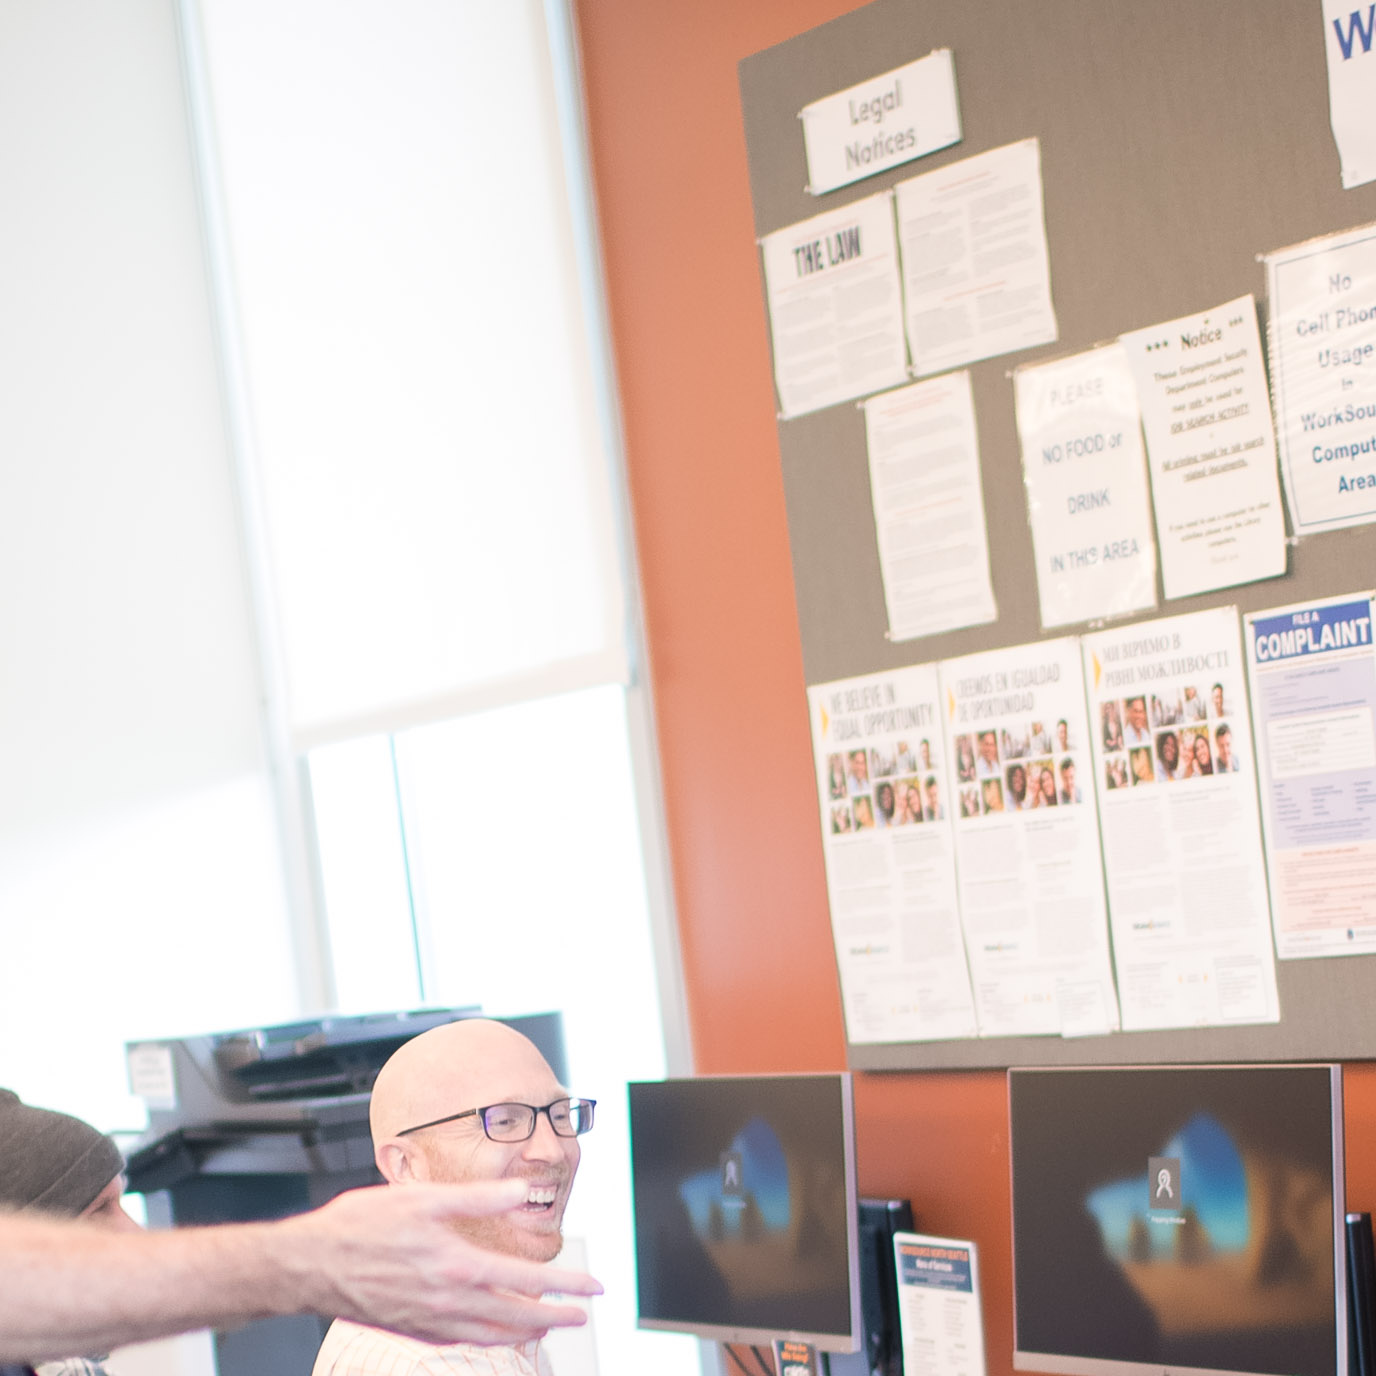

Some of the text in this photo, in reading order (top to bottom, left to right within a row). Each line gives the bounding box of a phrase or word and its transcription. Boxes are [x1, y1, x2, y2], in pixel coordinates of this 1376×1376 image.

[848, 79, 903, 125] Legal
[845, 128, 916, 171] Notices
[792, 240, 823, 278] THE
[826, 225, 862, 267] LAW
[1328, 272, 1352, 293] No
[1180, 328, 1222, 351] Notice
[1296, 313, 1330, 337] Cell
[1318, 343, 1374, 369] Usage
[1050, 377, 1104, 408] PLEASE
[1042, 431, 1123, 466] NO FOOD or
[1338, 473, 1376, 493] Area
[1067, 488, 1111, 515] DRINK
[1049, 538, 1140, 573] IN THIS AREA
[1292, 610, 1321, 626] FILE A
[1256, 617, 1371, 661] COMPLAINT
